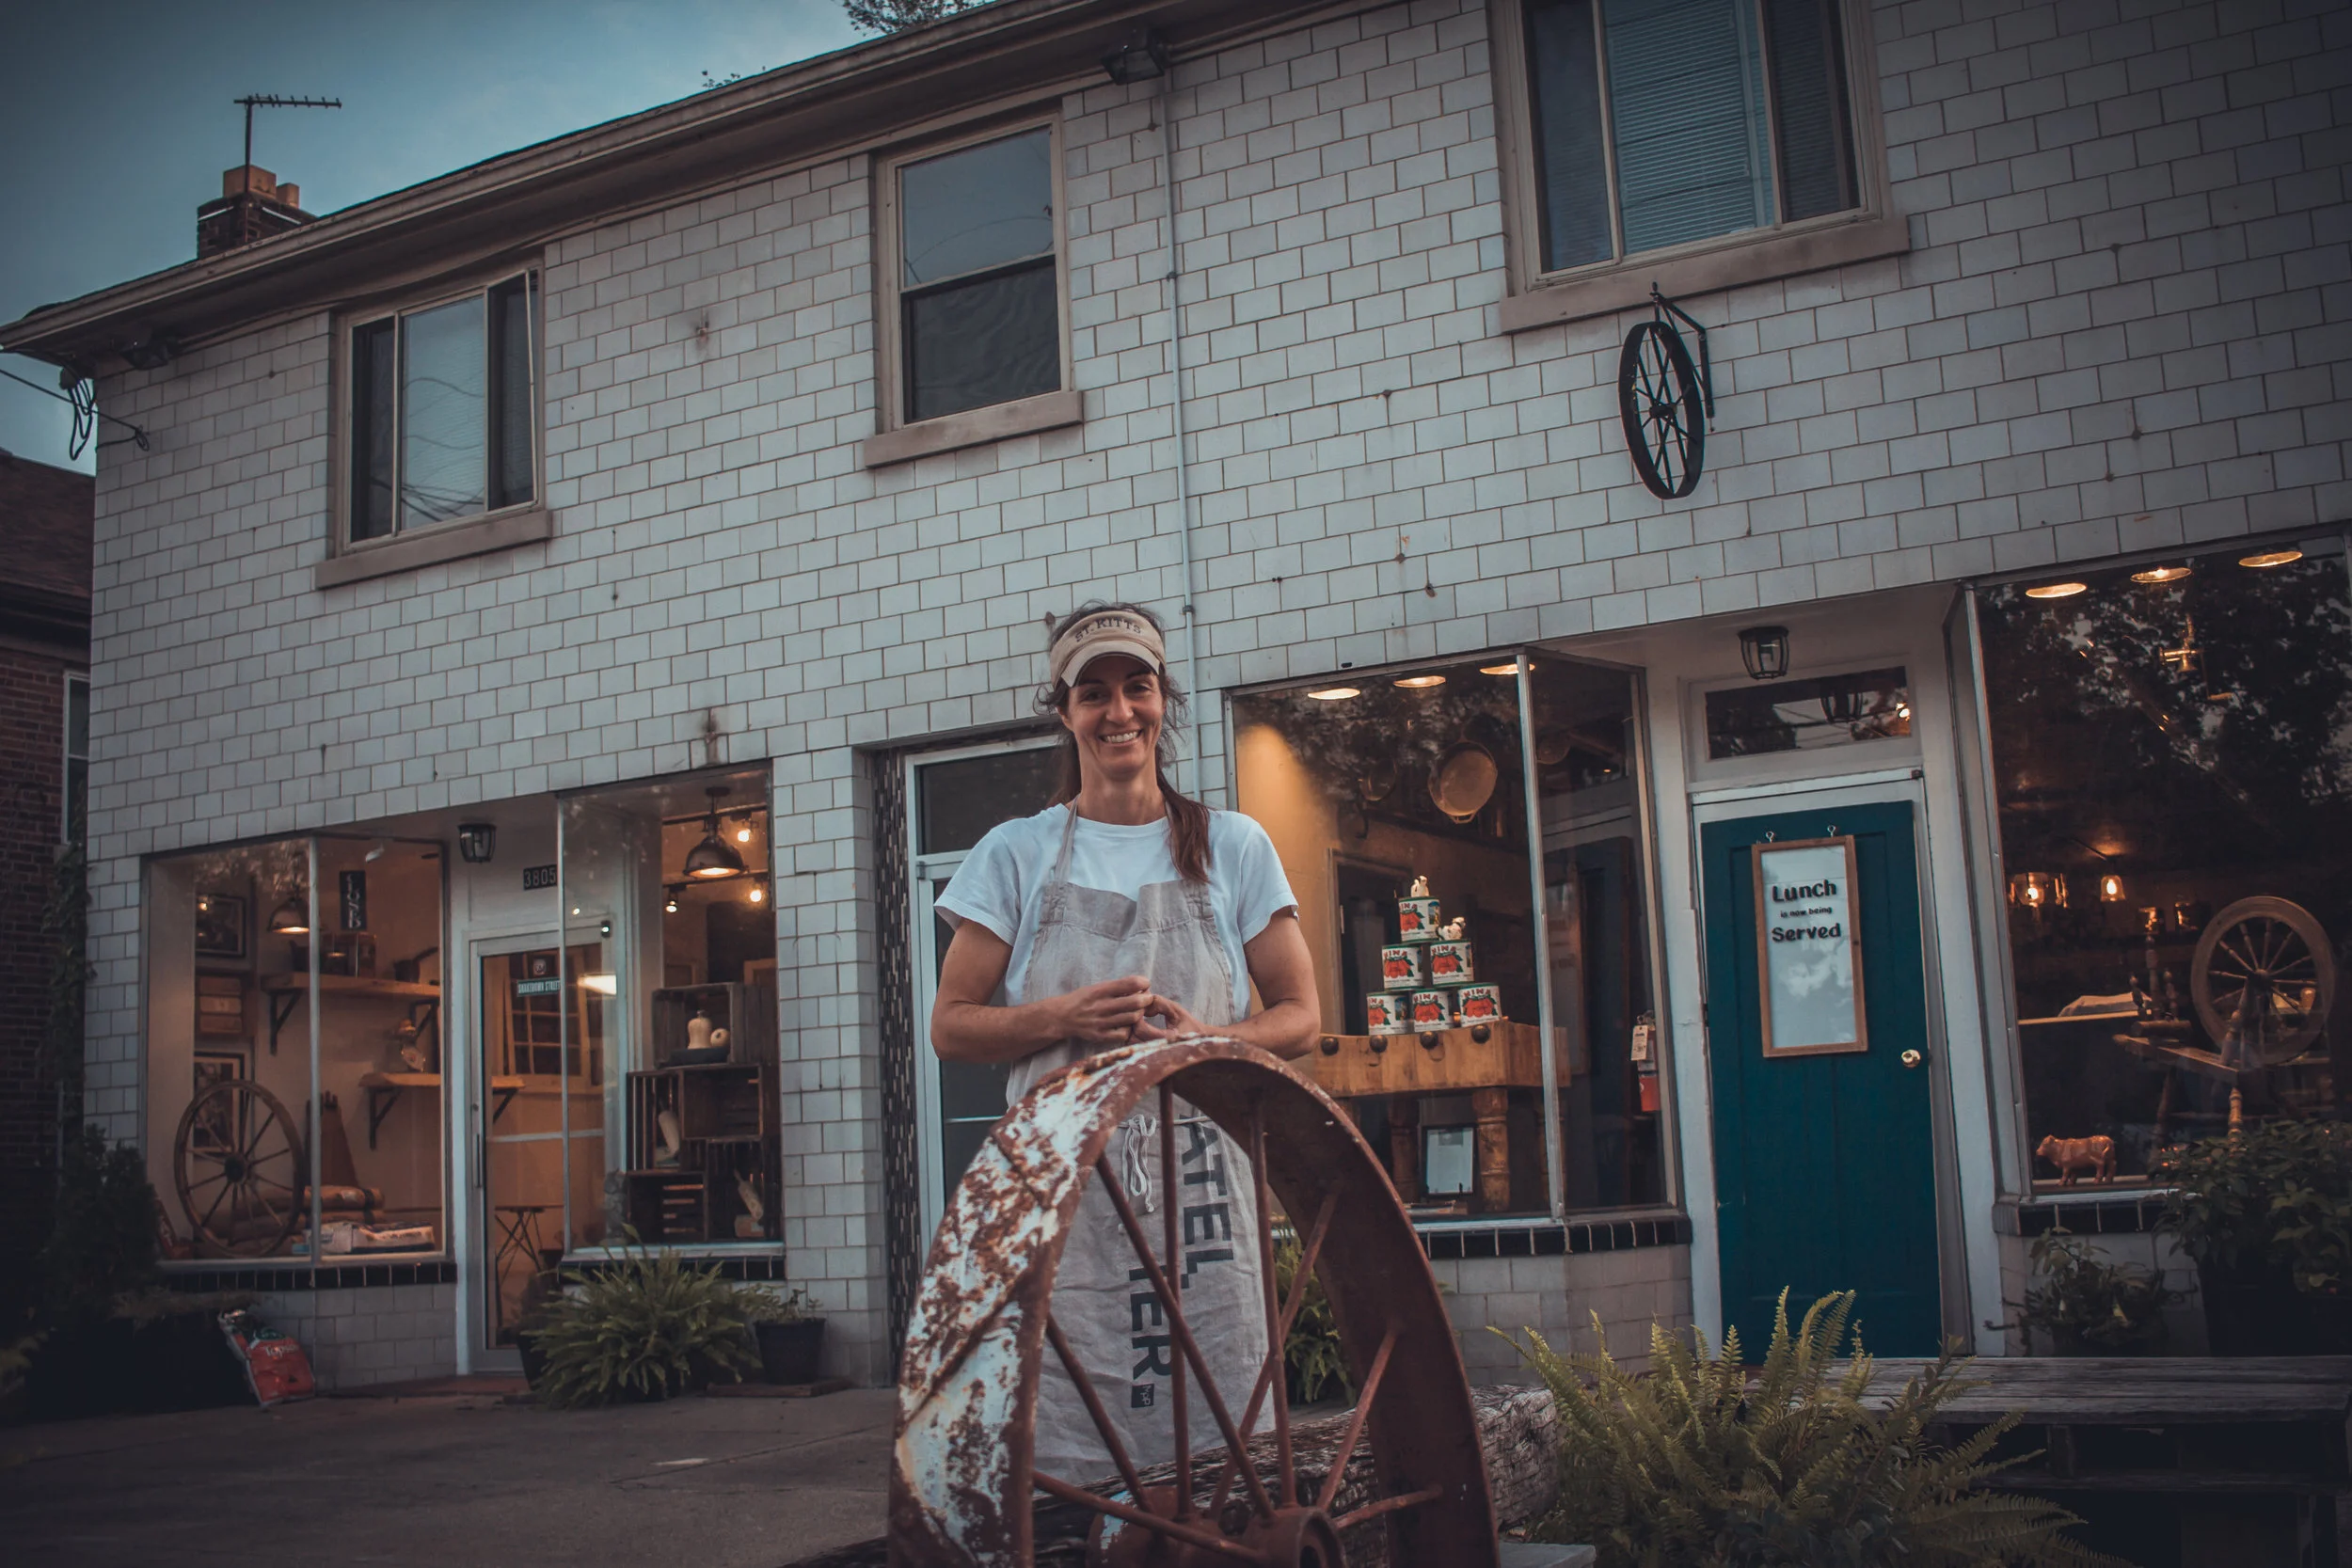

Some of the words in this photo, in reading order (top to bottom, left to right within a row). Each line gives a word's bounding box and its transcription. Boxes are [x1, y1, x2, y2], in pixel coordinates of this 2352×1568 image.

[1074, 624, 1094, 642] ST.
[1094, 616, 1142, 634] KITTS
[524, 867, 557, 889] 3805
[1772, 879, 1837, 903] Lunch
[1780, 911, 1788, 919] is
[1789, 909, 1807, 917] now
[1808, 906, 1833, 916] being
[1772, 923, 1842, 943] Served
[1431, 945, 1456, 956] NINA
[1413, 993, 1438, 1004] NINA
[1463, 988, 1491, 998] NINA
